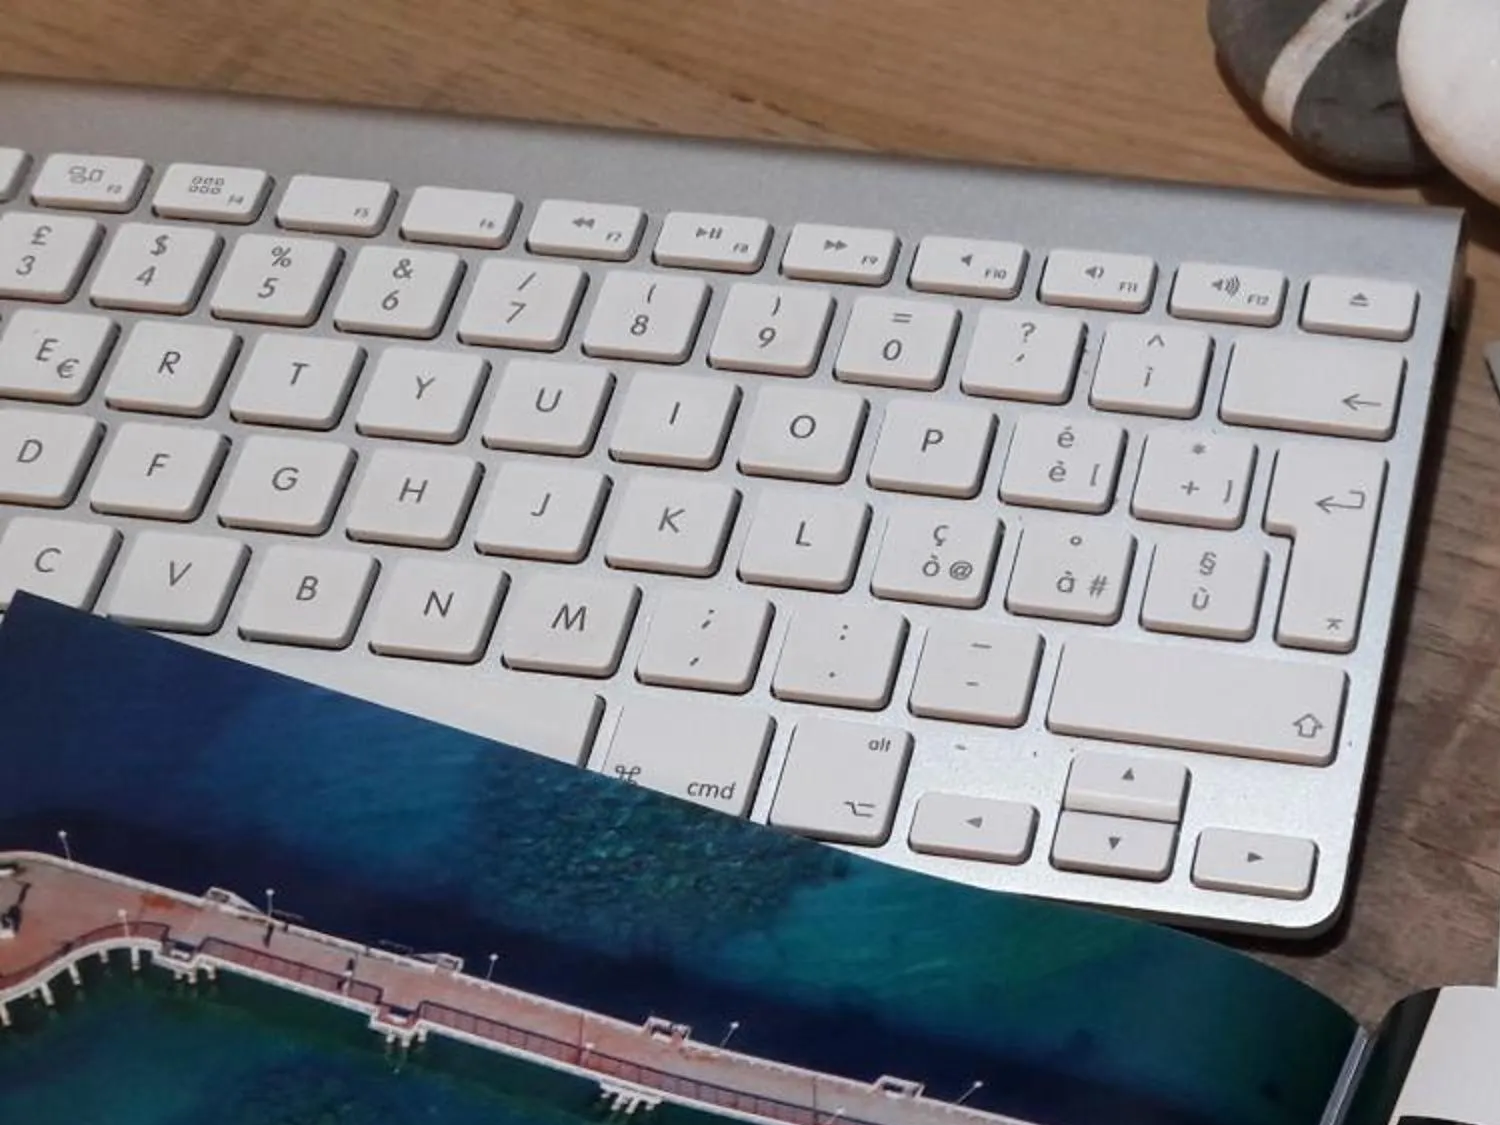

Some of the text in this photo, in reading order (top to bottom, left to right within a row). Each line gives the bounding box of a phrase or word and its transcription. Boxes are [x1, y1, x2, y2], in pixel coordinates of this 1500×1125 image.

[136, 265, 156, 286] 4
[257, 277, 278, 299] 5
[381, 289, 399, 311] 6
[506, 301, 527, 324] 7
[630, 314, 650, 336] 8
[758, 327, 777, 348] 9
[35, 338, 58, 362] E
[882, 339, 902, 361] 0
[157, 351, 181, 375] R
[290, 362, 309, 386] T
[415, 376, 435, 400] Y
[535, 387, 563, 413] U
[669, 401, 681, 425] I
[789, 415, 817, 439] O
[16, 439, 43, 464] D
[921, 428, 944, 453] P
[146, 453, 170, 477] F
[271, 466, 299, 491] G
[398, 477, 428, 504] H
[530, 492, 551, 517] J
[658, 507, 685, 534] K
[795, 521, 811, 547] L
[34, 547, 62, 573] C
[169, 561, 193, 587] V
[295, 575, 319, 601] B
[423, 590, 454, 618] N
[551, 604, 587, 632] M
[868, 738, 891, 752] alt
[687, 782, 736, 800] cmd
